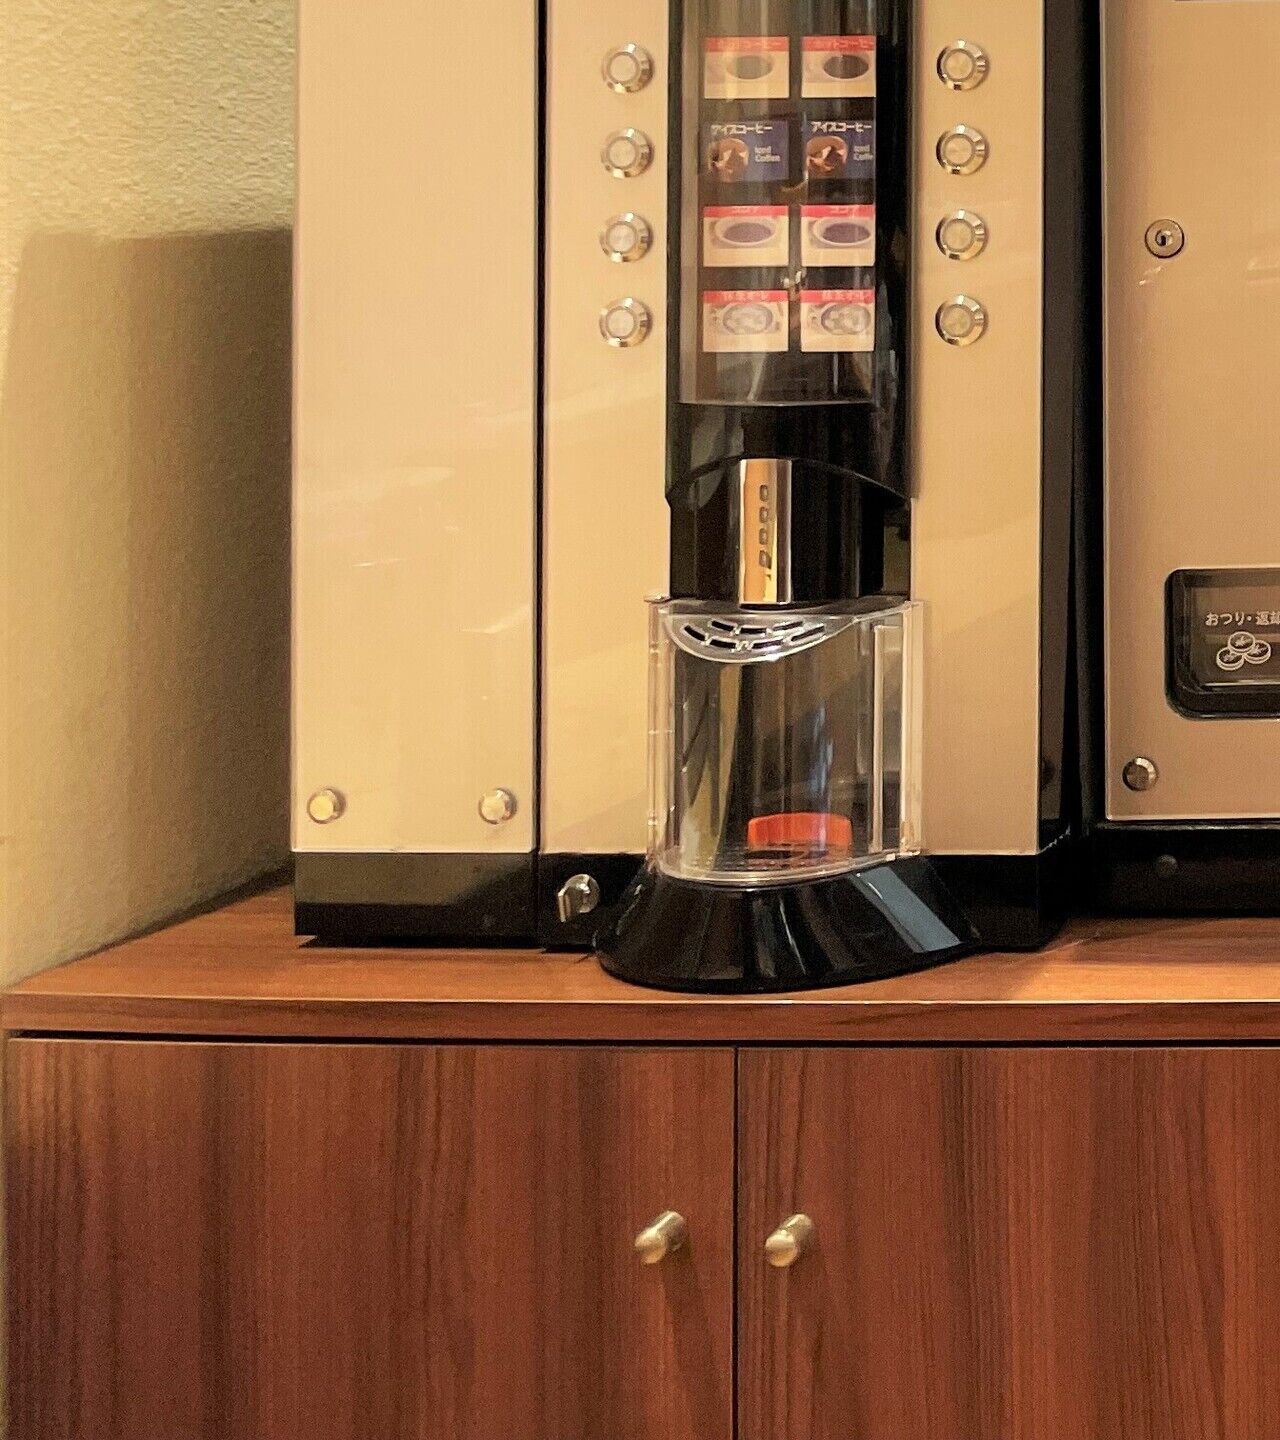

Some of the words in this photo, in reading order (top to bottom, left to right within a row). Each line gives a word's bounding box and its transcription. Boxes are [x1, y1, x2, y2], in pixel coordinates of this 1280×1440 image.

[710, 123, 773, 135] アイスコーヒー
[811, 121, 872, 133] アイスコーヒー
